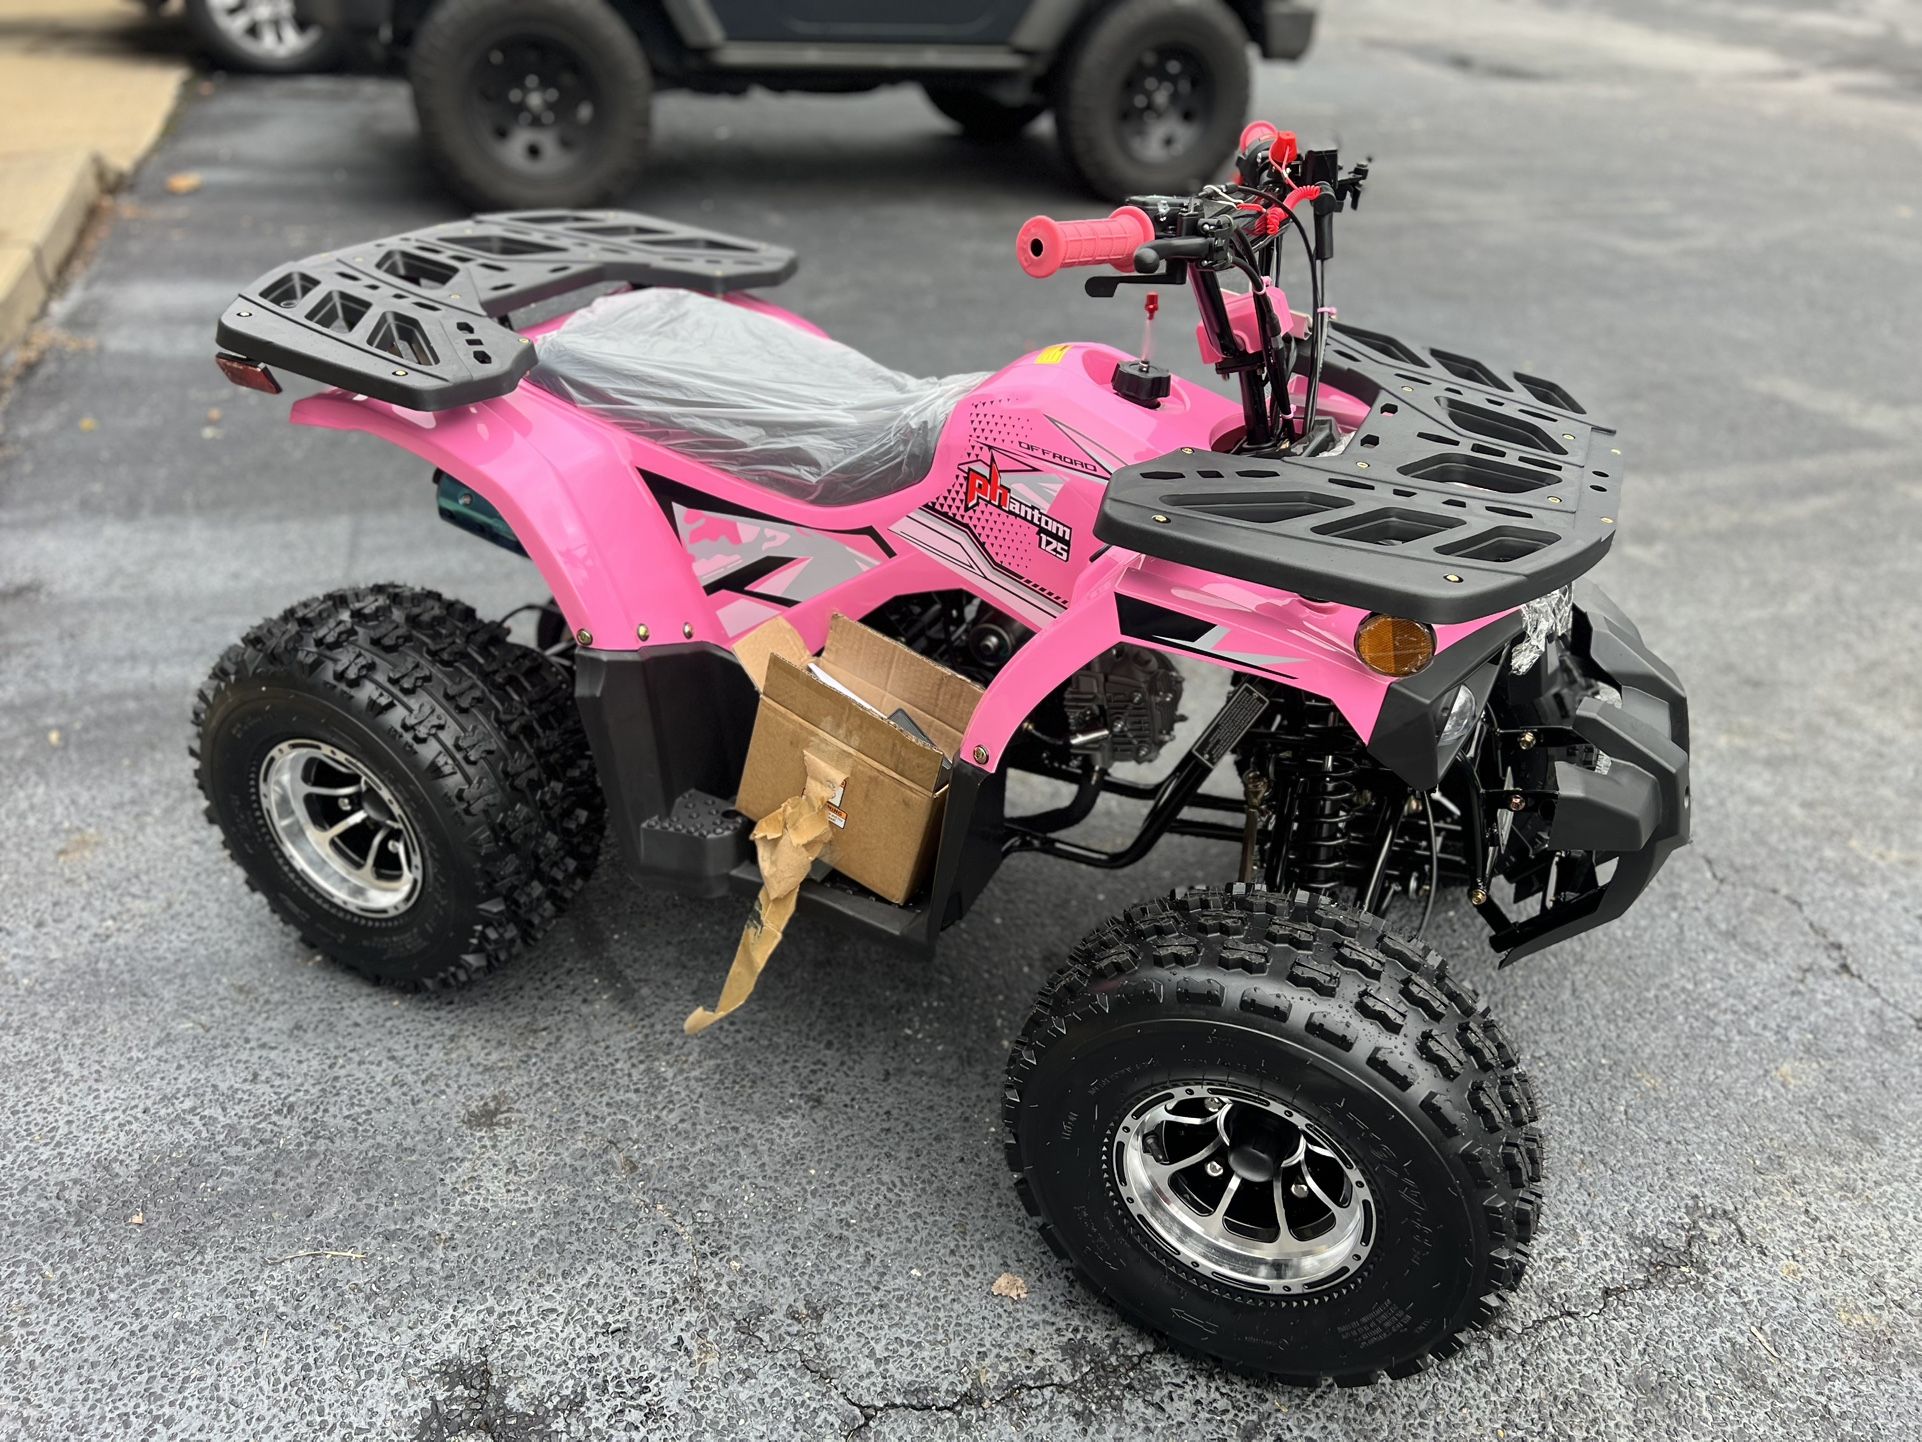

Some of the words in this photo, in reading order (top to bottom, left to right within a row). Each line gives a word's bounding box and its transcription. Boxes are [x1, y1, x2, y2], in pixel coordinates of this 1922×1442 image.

[1019, 441, 1097, 472] OFFROAD
[965, 456, 1072, 541] phantom
[1038, 533, 1069, 562] 125
